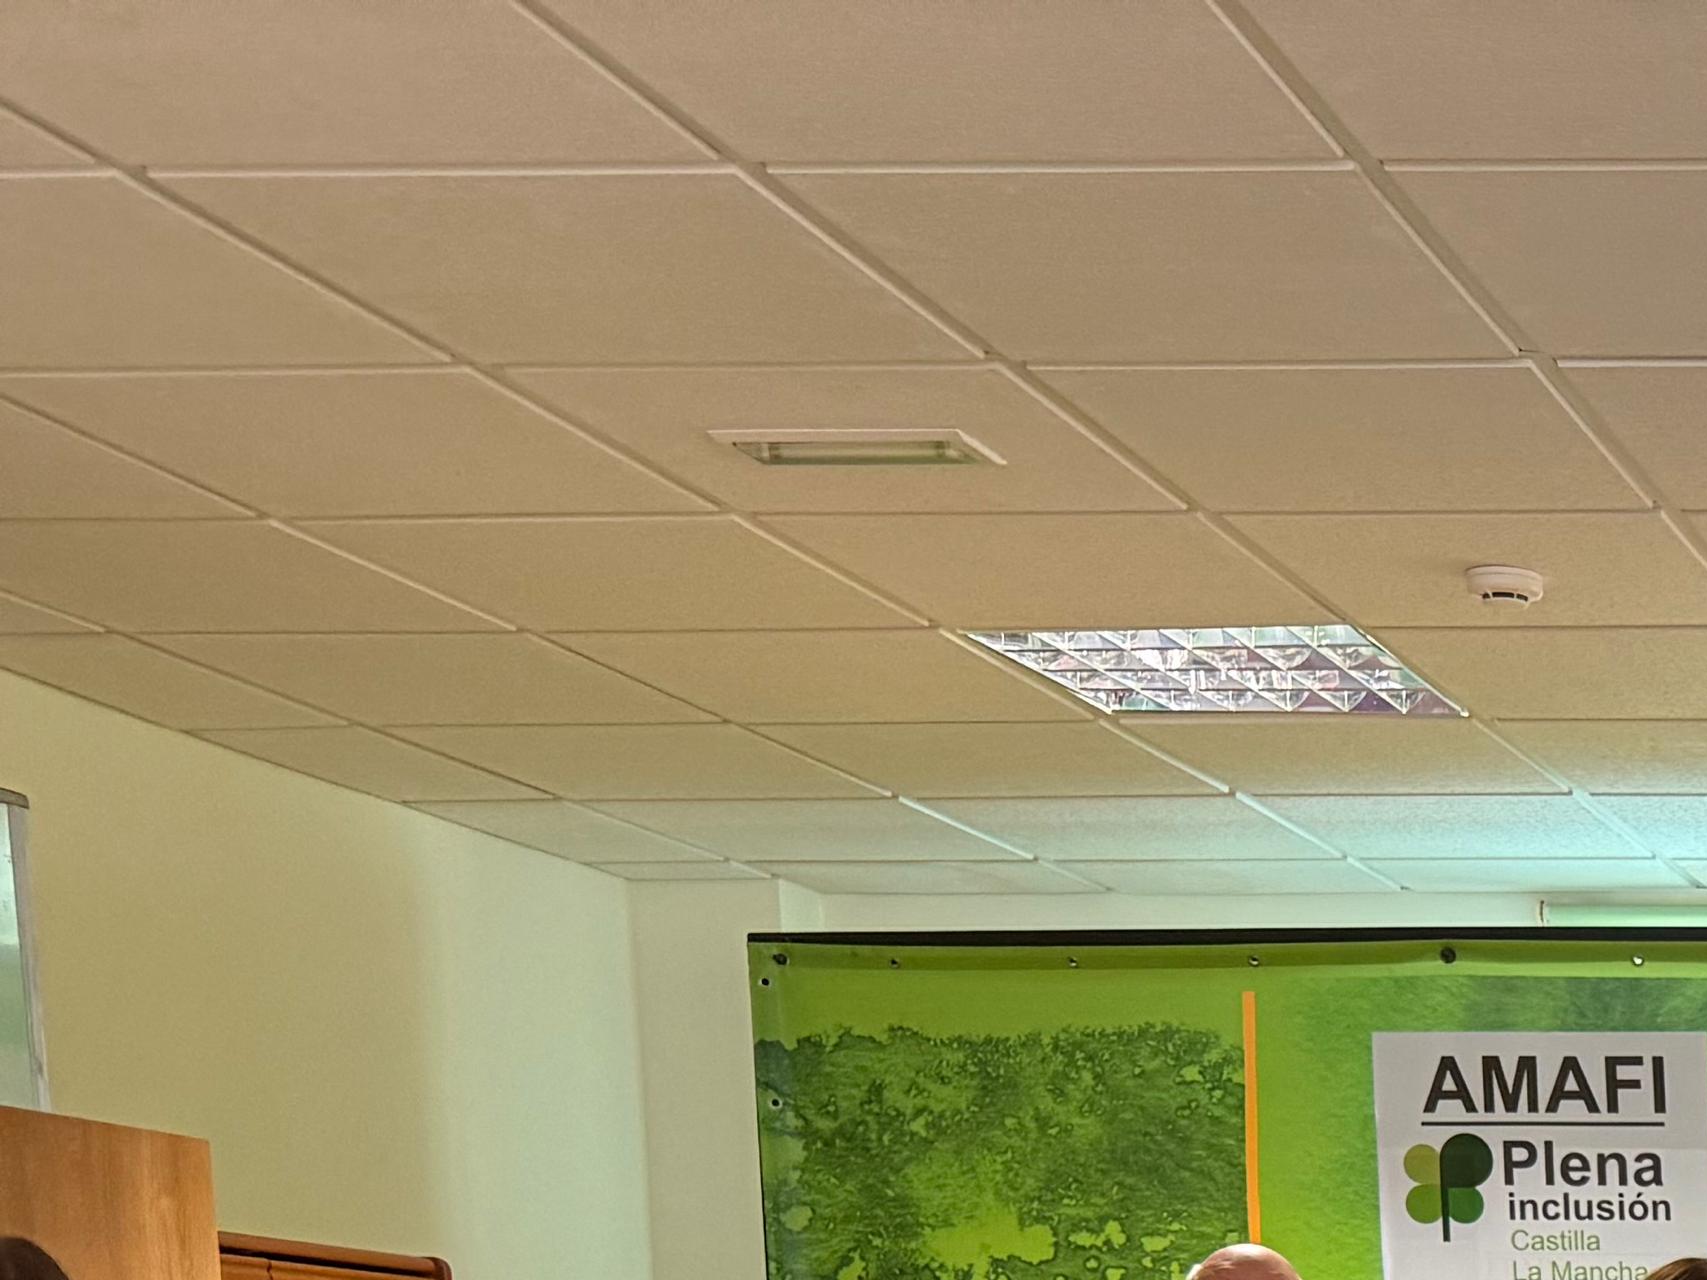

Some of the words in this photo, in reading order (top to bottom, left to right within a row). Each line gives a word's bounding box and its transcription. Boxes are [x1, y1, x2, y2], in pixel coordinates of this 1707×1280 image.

[1423, 1055, 1667, 1114] AMAFI
[1502, 1140, 1664, 1187] Plena
[1508, 1191, 1672, 1222] inclusión
[1510, 1228, 1601, 1251] Castilla
